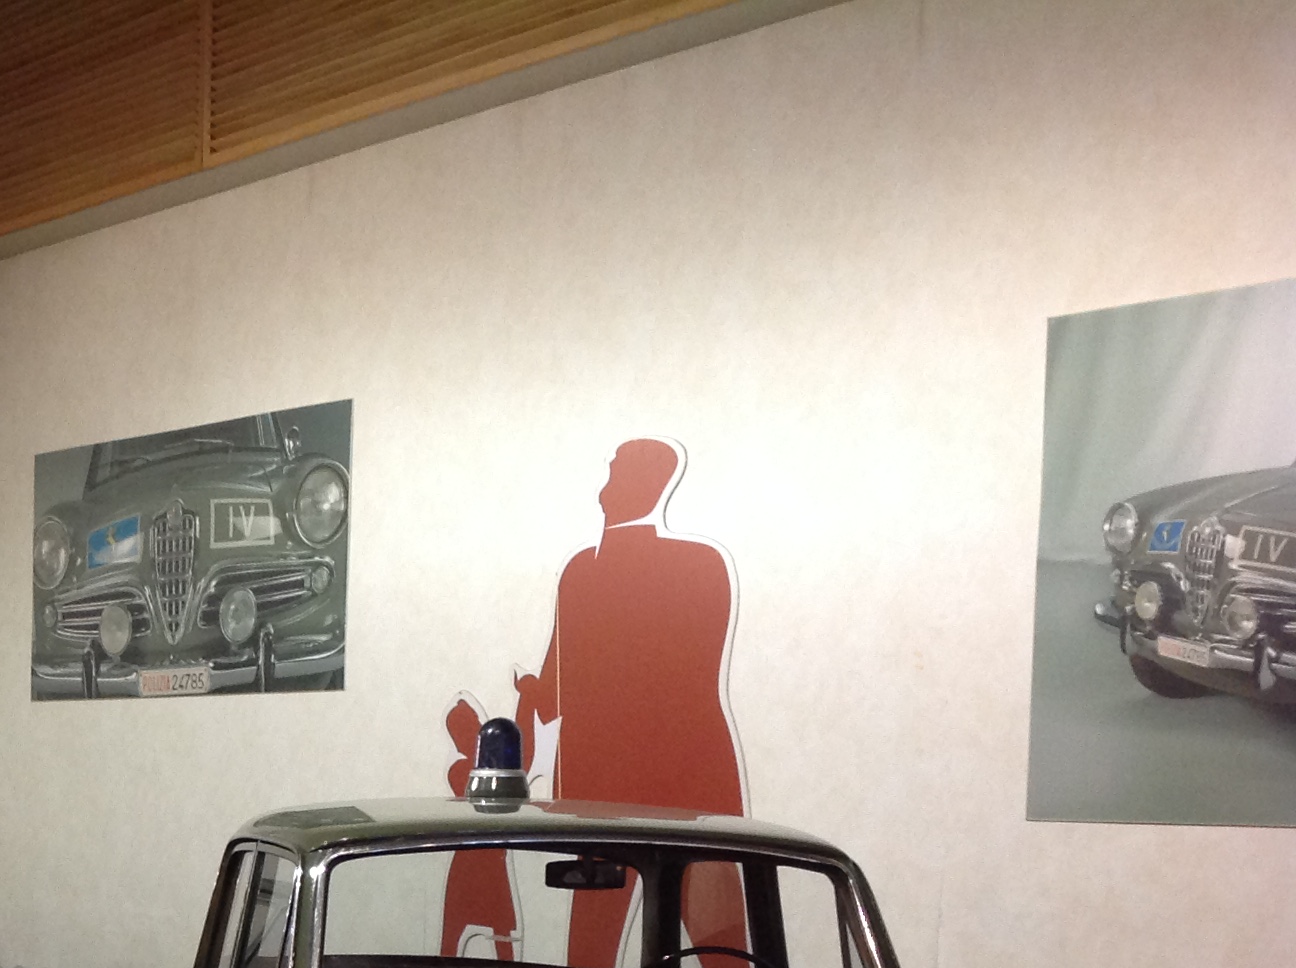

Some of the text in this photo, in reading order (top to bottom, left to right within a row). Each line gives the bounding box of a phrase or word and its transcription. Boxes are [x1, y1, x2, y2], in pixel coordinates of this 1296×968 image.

[229, 505, 255, 539] IV
[1253, 534, 1288, 563] IV
[172, 672, 205, 691] 24785
